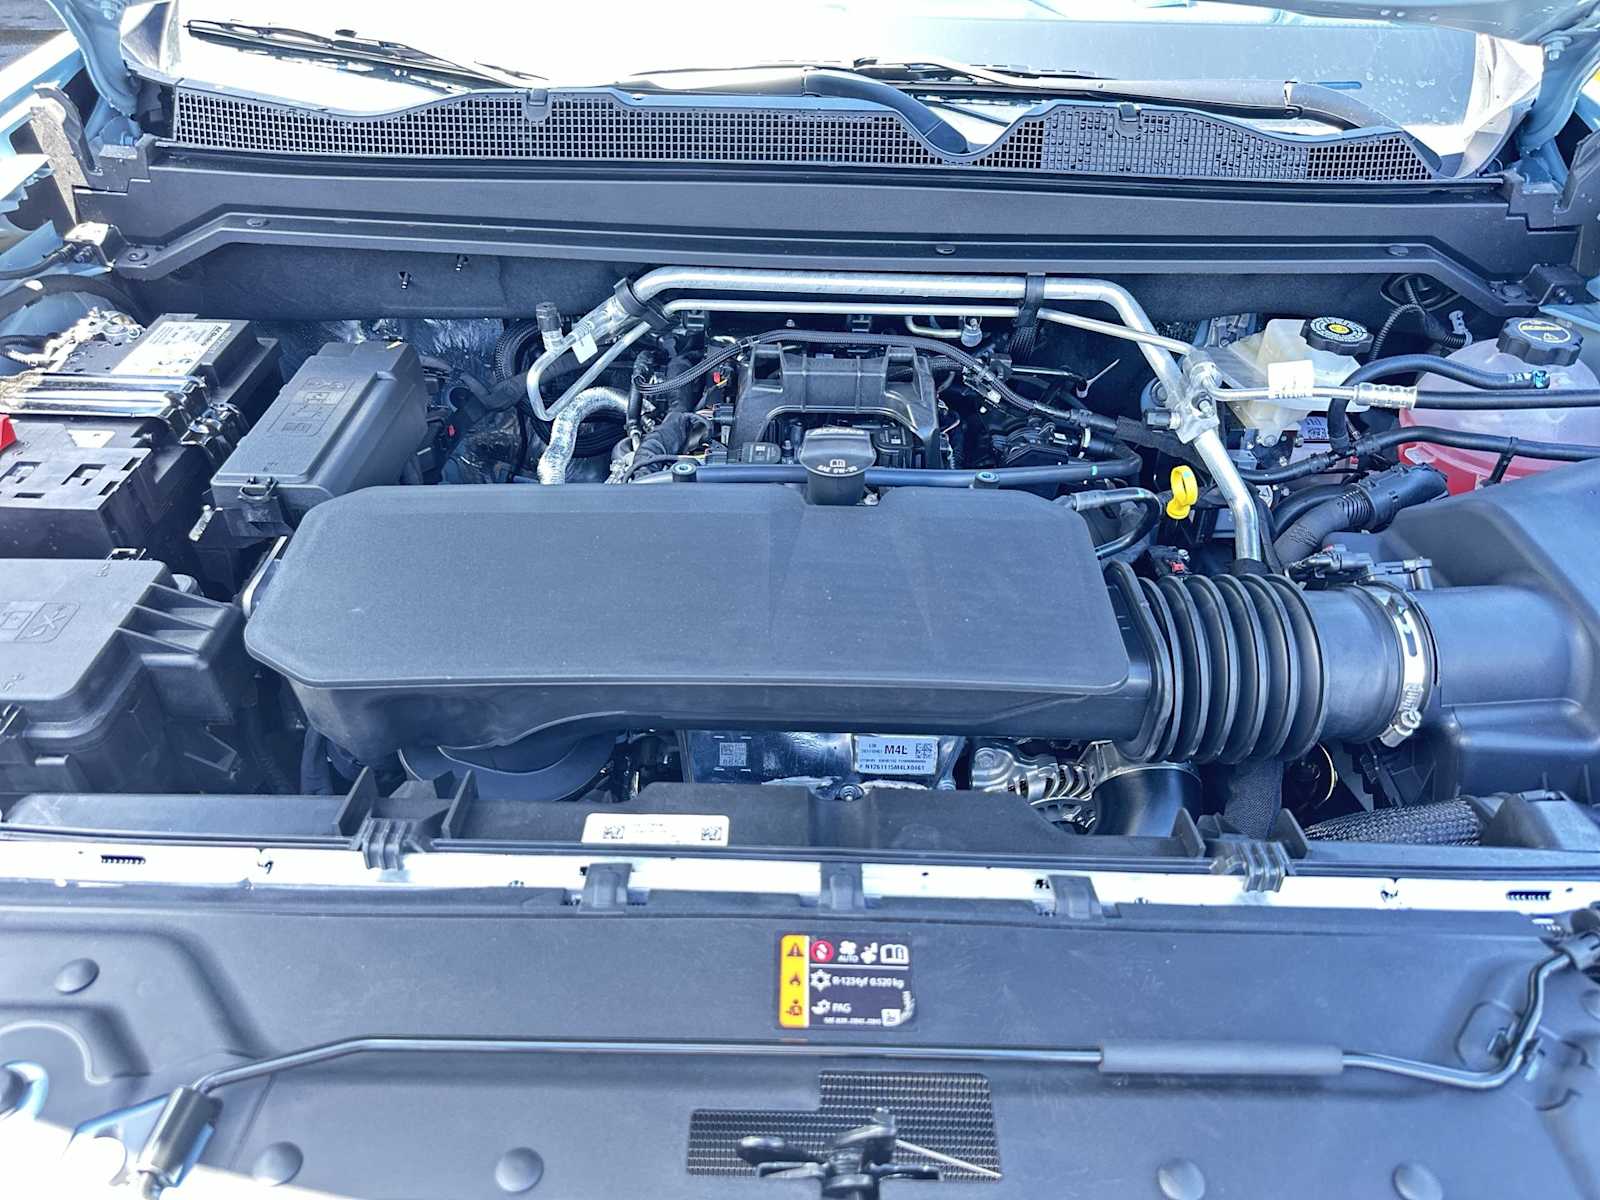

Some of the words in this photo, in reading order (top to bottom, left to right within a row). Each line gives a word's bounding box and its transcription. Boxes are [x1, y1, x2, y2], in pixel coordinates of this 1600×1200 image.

[884, 745, 908, 755] M4L
[837, 955, 859, 963] AUTO
[893, 977, 904, 989] kg
[832, 1003, 852, 1013] PAG
